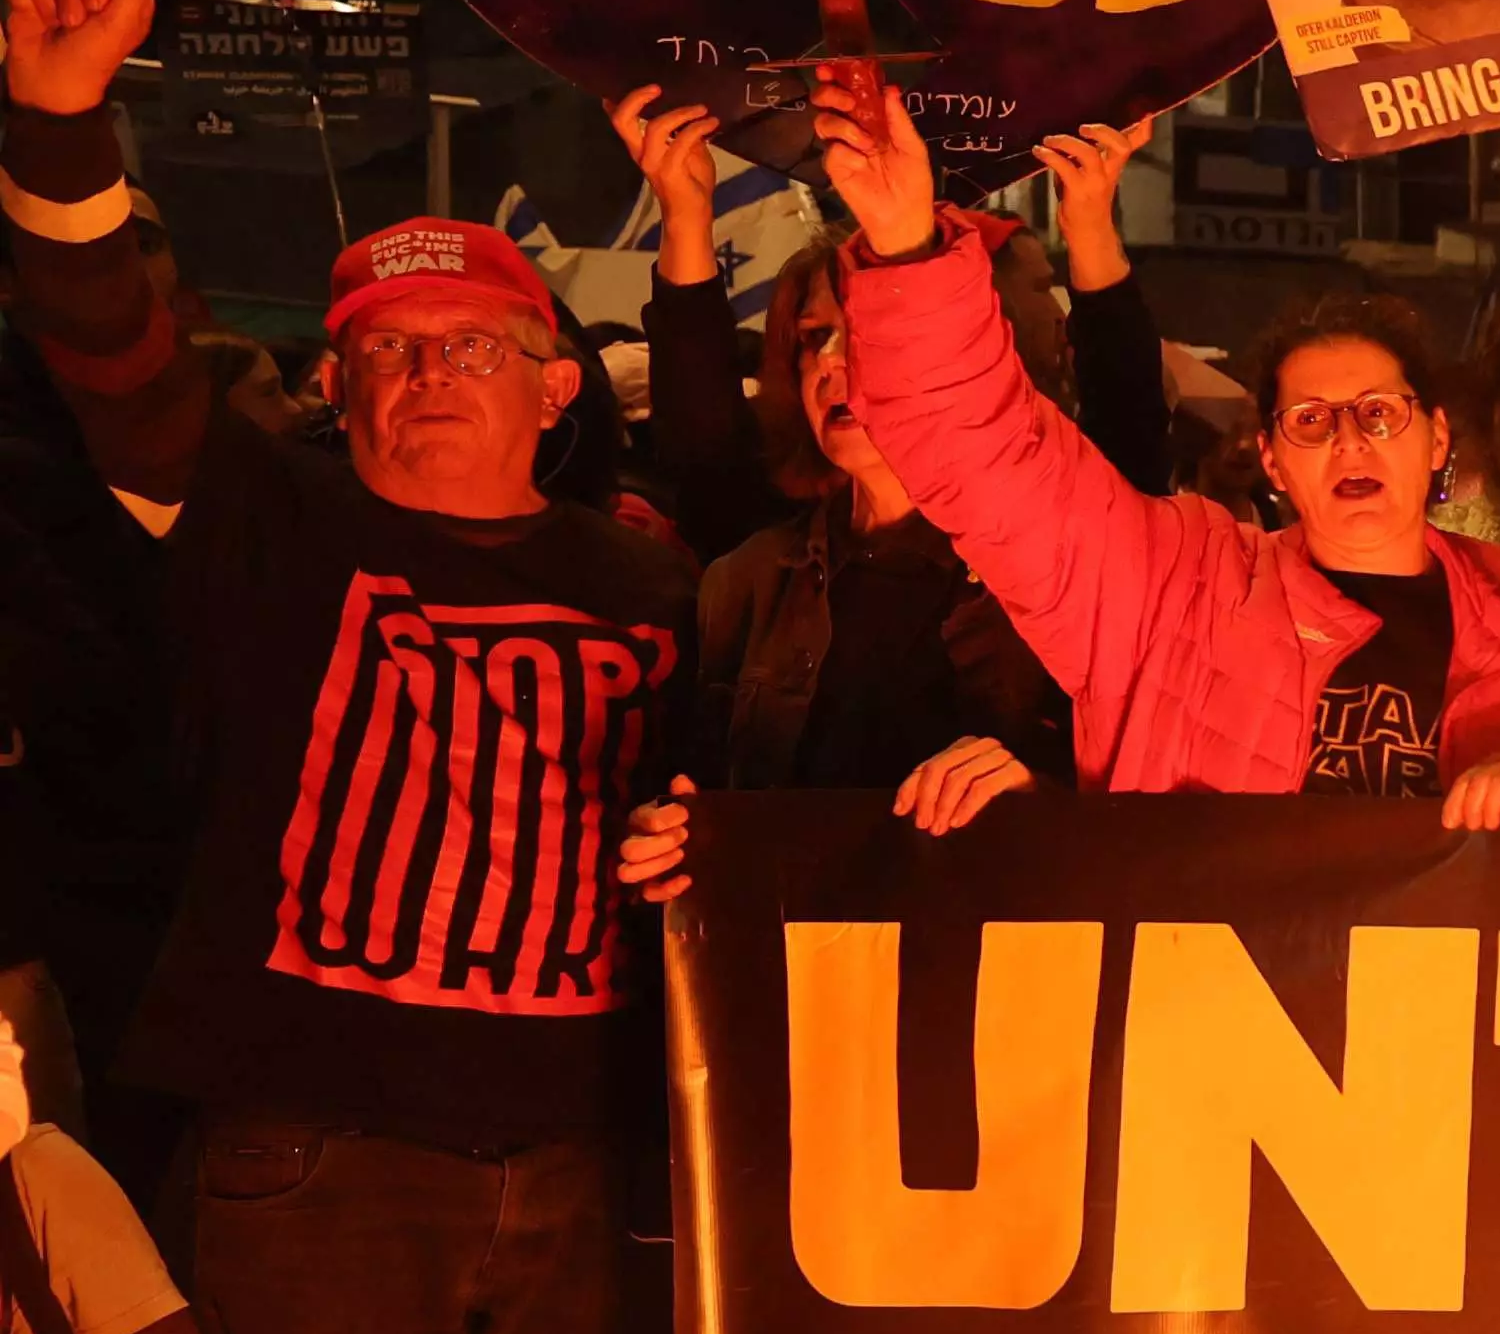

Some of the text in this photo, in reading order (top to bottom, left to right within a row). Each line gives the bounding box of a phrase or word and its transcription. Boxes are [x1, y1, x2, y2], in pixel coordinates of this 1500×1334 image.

[370, 230, 465, 254] END THIS
[372, 253, 466, 280] WAR
